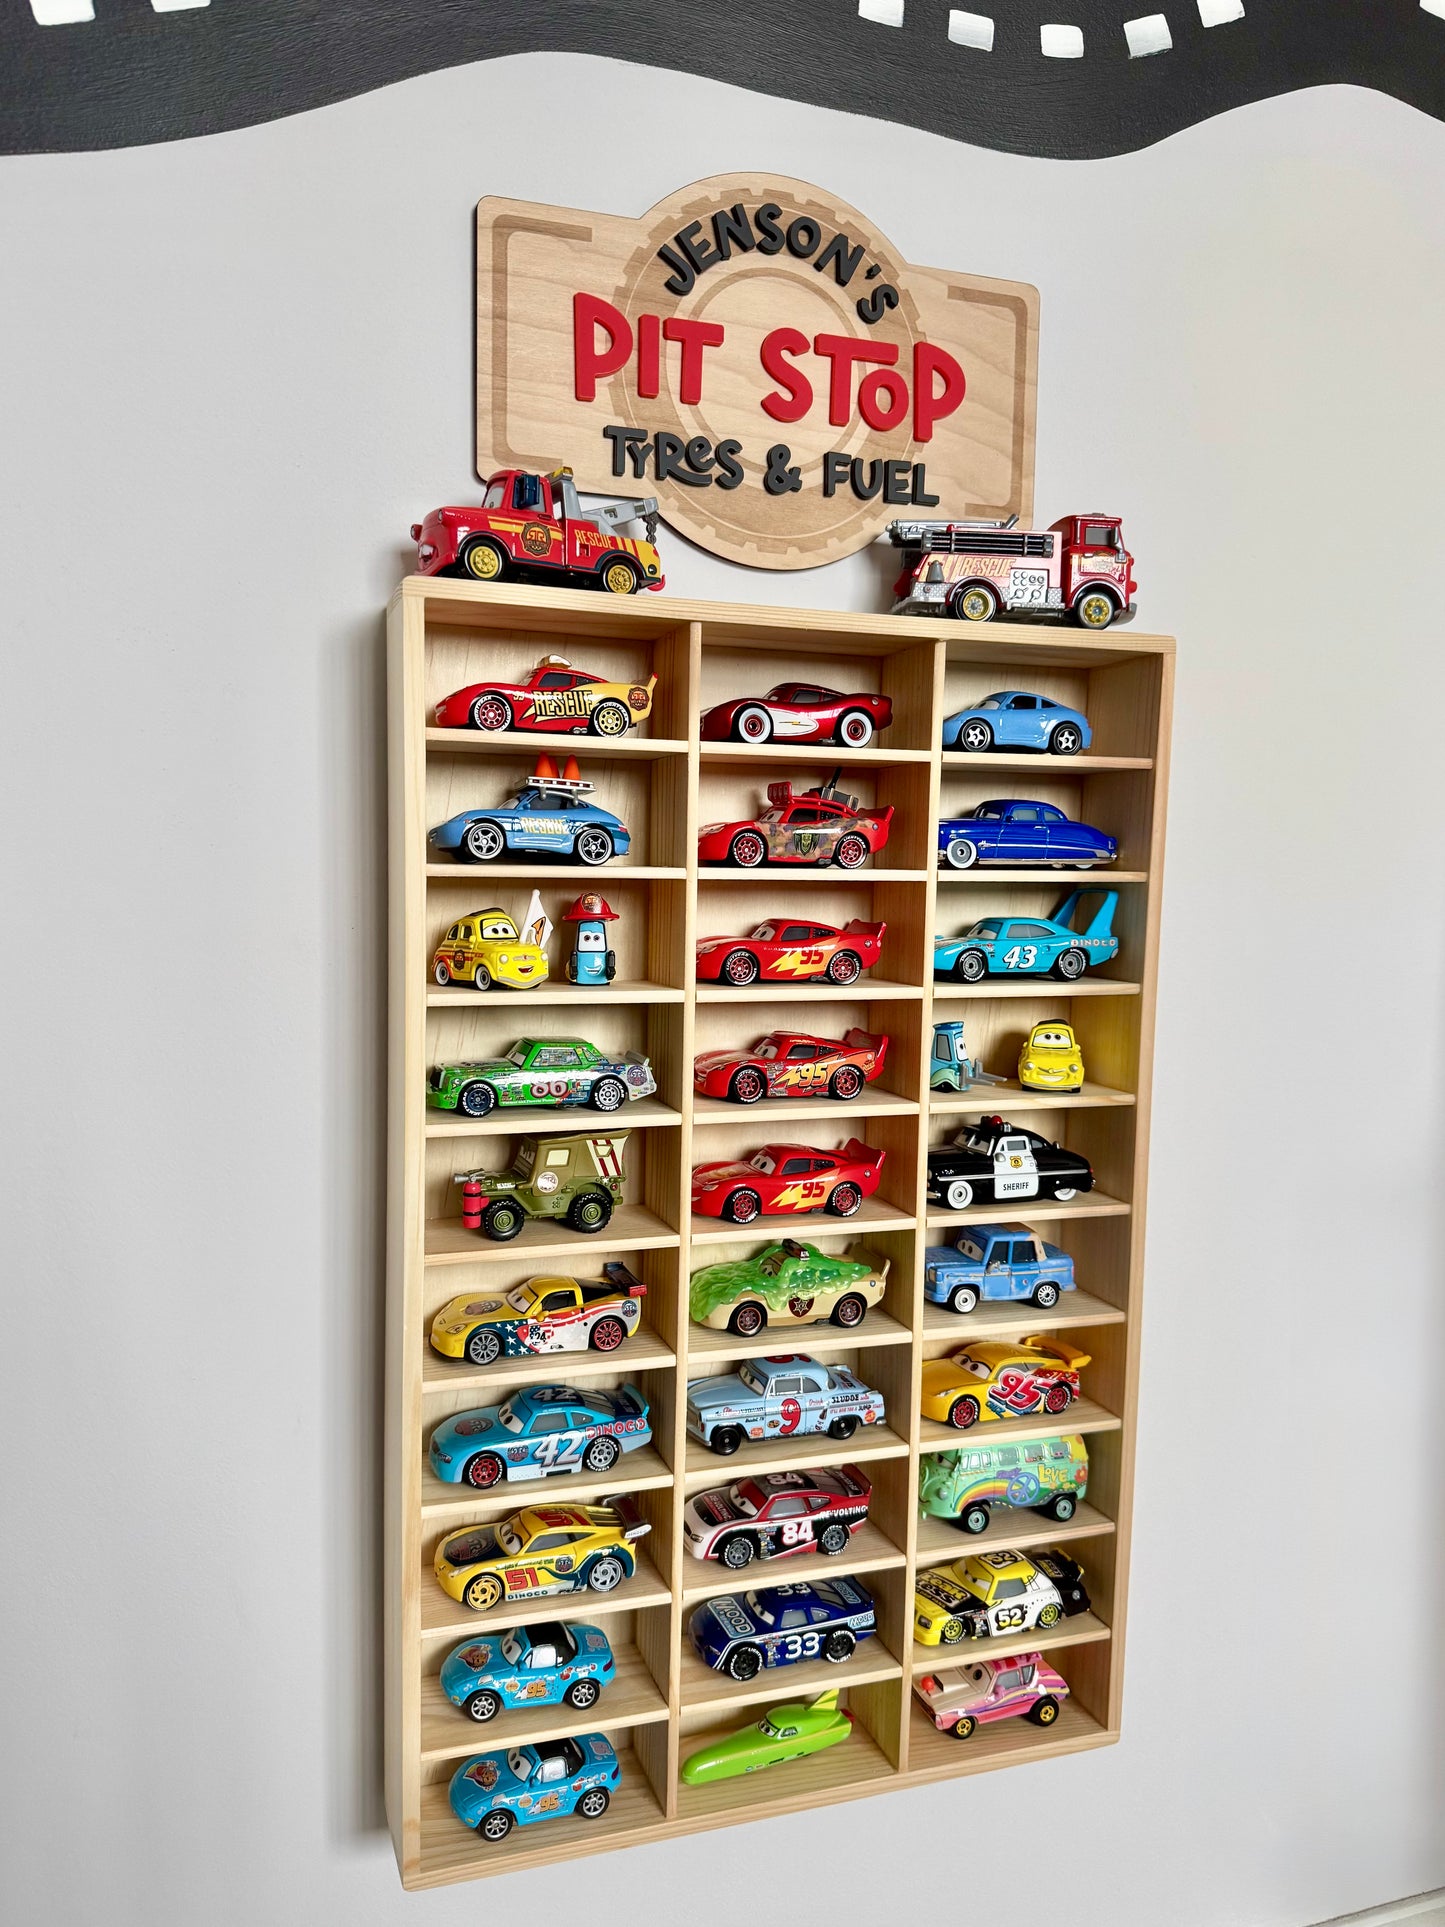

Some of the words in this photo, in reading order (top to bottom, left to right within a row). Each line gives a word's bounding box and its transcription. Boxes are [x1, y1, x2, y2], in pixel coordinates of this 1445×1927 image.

[658, 202, 900, 325] JENSON'S
[573, 292, 725, 406] PIT
[760, 327, 967, 443] STOP
[603, 425, 744, 491] TYRES
[764, 444, 803, 496] &
[823, 451, 940, 507] FUEL
[574, 529, 615, 550] RESCUE
[959, 557, 1017, 578] RESCUE
[532, 690, 593, 716] RESCUE
[800, 949, 824, 965] 95
[1003, 945, 1038, 969] 43
[798, 1062, 828, 1087] 95
[801, 1182, 826, 1199] 95
[1003, 1182, 1029, 1191] SHERIFF
[532, 1387, 578, 1402] 42
[988, 1369, 1047, 1410] 95
[779, 1397, 802, 1434] 9
[585, 1418, 647, 1439] DINOCO
[532, 1431, 585, 1468] 42
[766, 1472, 804, 1485] 84
[1038, 1463, 1068, 1483] LOVE
[534, 1509, 591, 1526] 51
[782, 1521, 814, 1545] 84
[505, 1566, 540, 1591] 51
[507, 1589, 549, 1600] DINOCO
[711, 1599, 752, 1634] MOOD
[996, 1606, 1024, 1629] 52
[785, 1631, 820, 1659] 33
[526, 1681, 547, 1698] 95
[540, 1793, 560, 1812] 95
